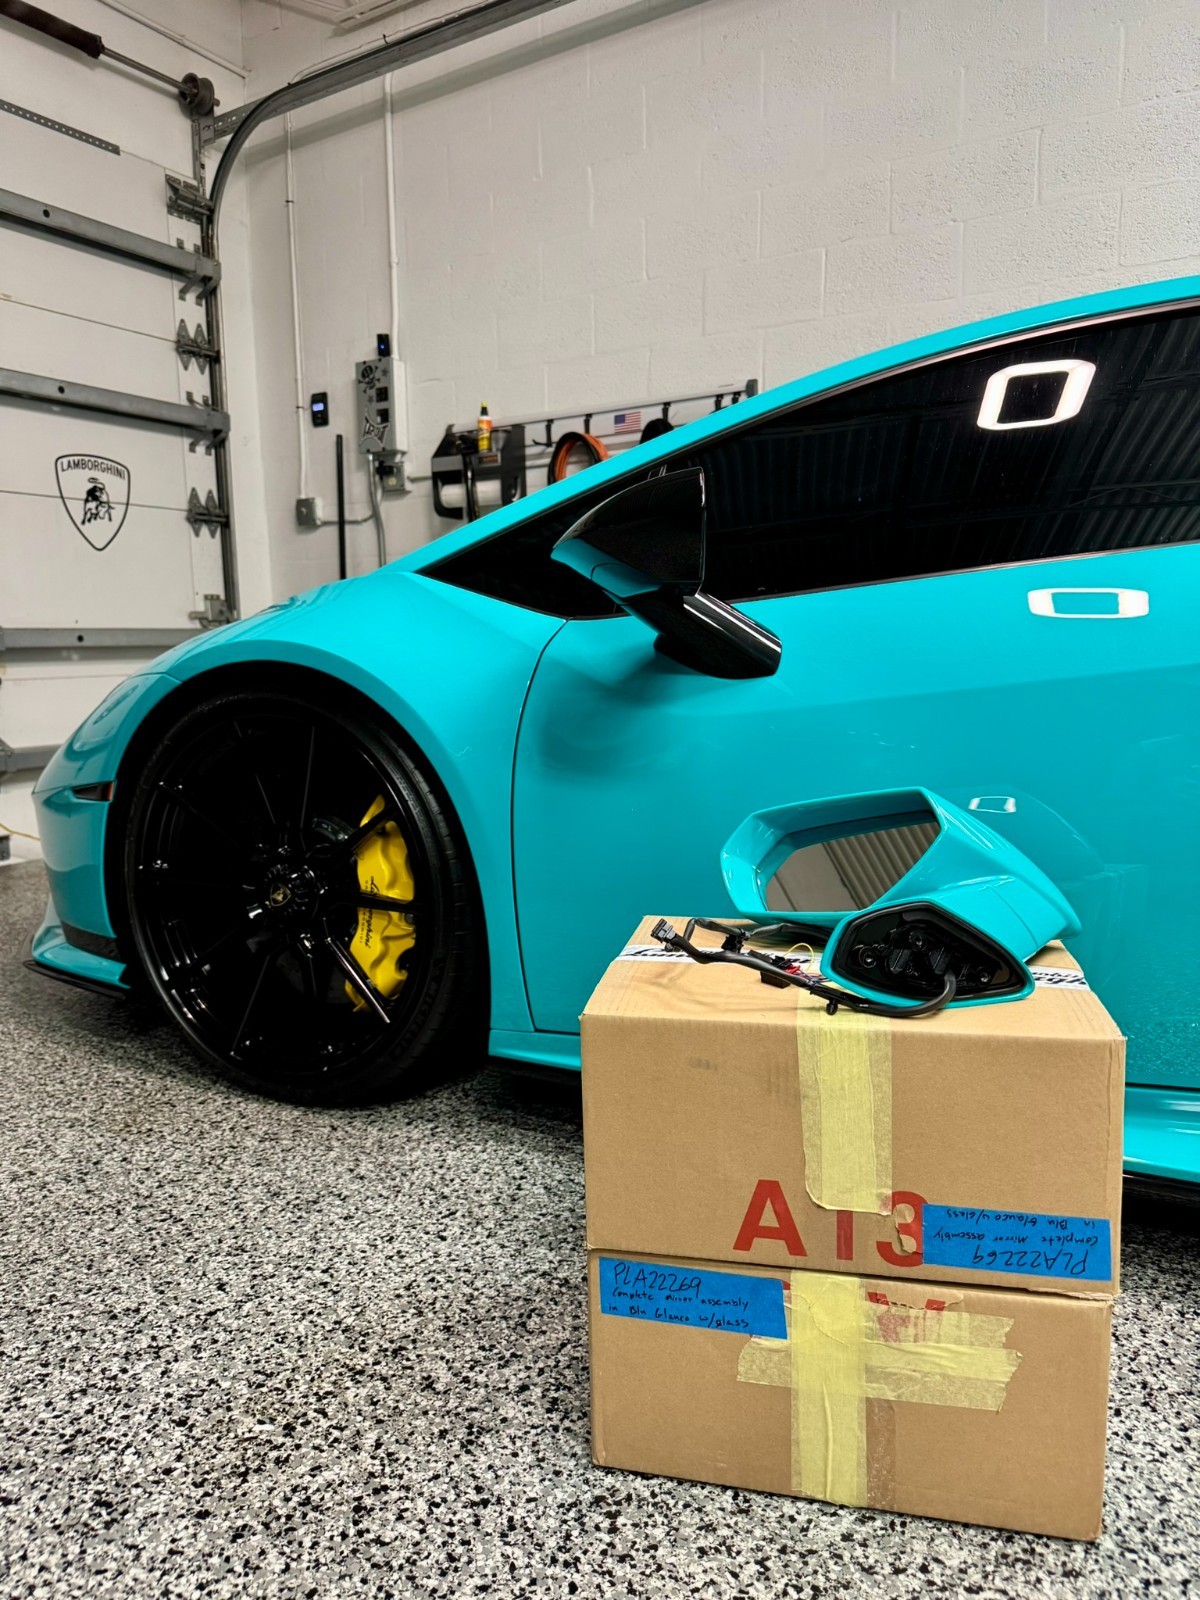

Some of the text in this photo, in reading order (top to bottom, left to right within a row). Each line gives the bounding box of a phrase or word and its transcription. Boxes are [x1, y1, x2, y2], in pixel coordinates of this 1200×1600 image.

[60, 458, 126, 480] LAMBORGHINI
[1047, 1219, 1068, 1230] Blu
[1084, 1220, 1096, 1229] in
[933, 1226, 985, 1241] assembly
[972, 1244, 1089, 1276] PLA22269
[613, 1262, 702, 1298] PLA22269
[608, 1304, 618, 1312] in
[701, 1296, 749, 1312] assembly
